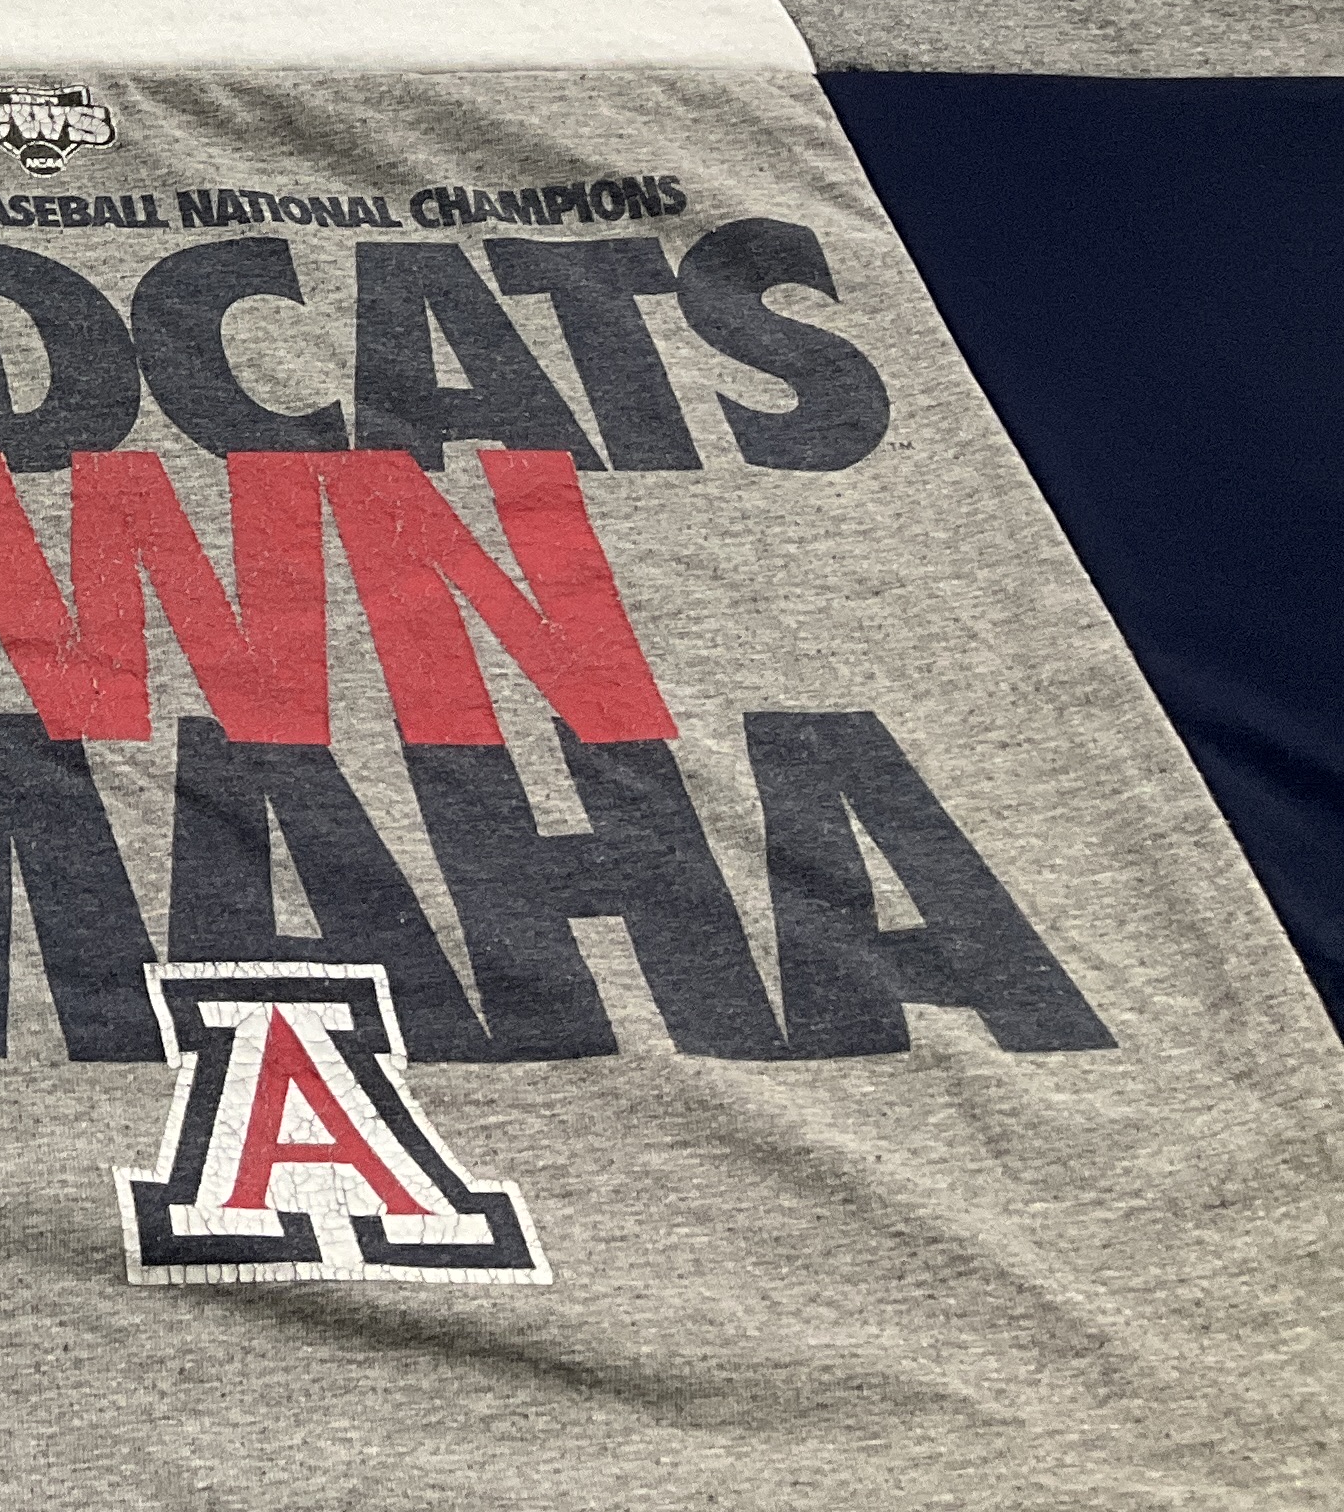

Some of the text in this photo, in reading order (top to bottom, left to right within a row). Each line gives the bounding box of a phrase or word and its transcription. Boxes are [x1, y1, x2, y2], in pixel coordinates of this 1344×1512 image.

[176, 188, 403, 229] NATIONAL
[410, 174, 688, 229] CHAMPIONS
[112, 959, 554, 1289] A
